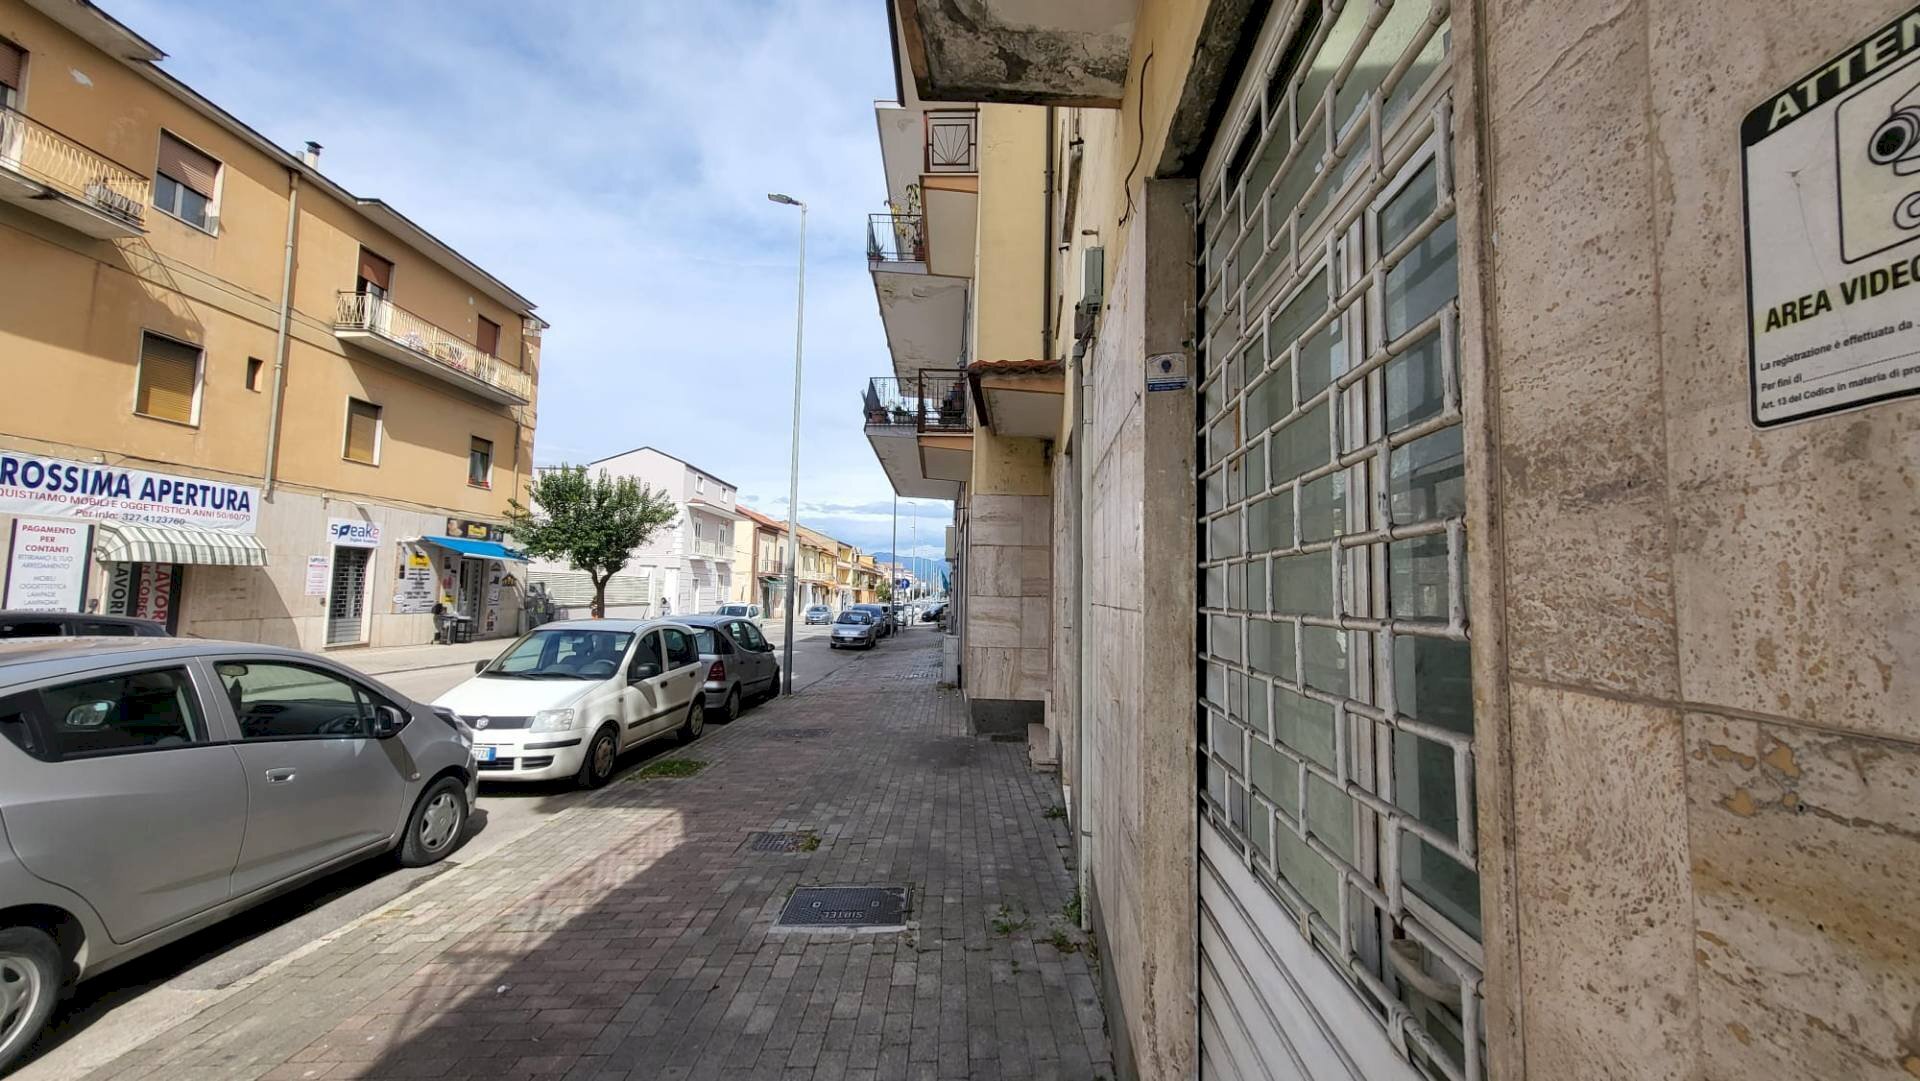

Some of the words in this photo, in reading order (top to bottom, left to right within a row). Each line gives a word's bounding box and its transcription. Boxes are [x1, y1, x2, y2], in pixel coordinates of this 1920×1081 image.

[1765, 289, 1832, 333] AREA
[1760, 362, 1771, 371] La
[1772, 343, 1832, 367] registrazione
[1834, 340, 1840, 349] è
[1843, 324, 1895, 347] effettuata
[1898, 320, 1913, 331] da
[1761, 382, 1777, 392] Per
[1777, 376, 1791, 388] fini
[1793, 373, 1802, 383] di
[1761, 400, 1775, 410] Art.
[1777, 396, 1787, 406] 13
[1788, 392, 1802, 403] del
[1803, 385, 1835, 399] Codice
[1837, 382, 1846, 392] in
[1848, 371, 1887, 389] materia
[1889, 366, 1900, 379] di
[0, 457, 131, 498] ROSSIMA
[140, 477, 250, 513] APERTURA
[121, 501, 191, 516] OGGETTISTICA
[192, 509, 214, 518] ANNI
[121, 513, 142, 522] 327
[22, 524, 76, 535] PAGAMENTO
[25, 544, 69, 553] CONTANTI
[110, 561, 130, 614] LAVORI
